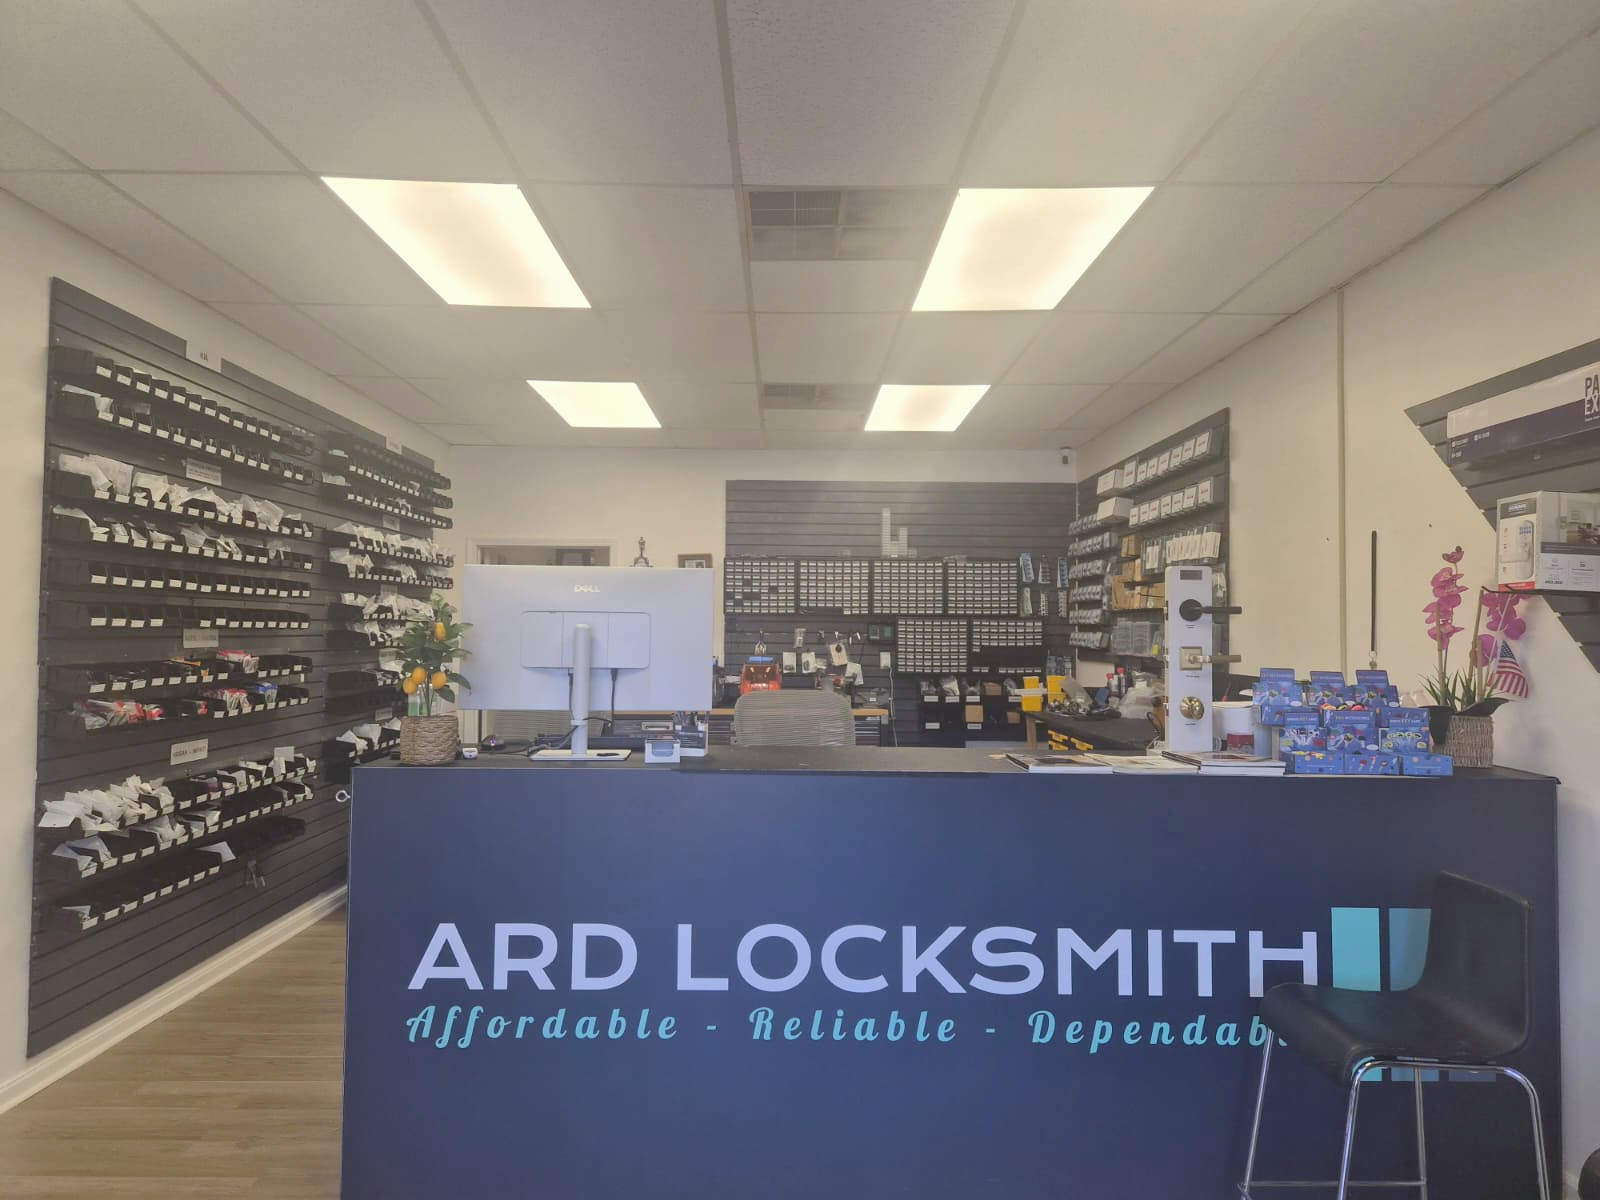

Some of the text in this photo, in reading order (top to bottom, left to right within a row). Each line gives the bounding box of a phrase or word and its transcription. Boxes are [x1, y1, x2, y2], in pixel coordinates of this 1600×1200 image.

[574, 584, 601, 593] DELL
[407, 922, 1318, 998] ARD LOCKSMITH
[405, 1005, 678, 1049] Affordable
[748, 1006, 956, 1042] Reliable
[1027, 1010, 1288, 1054] Dependab
